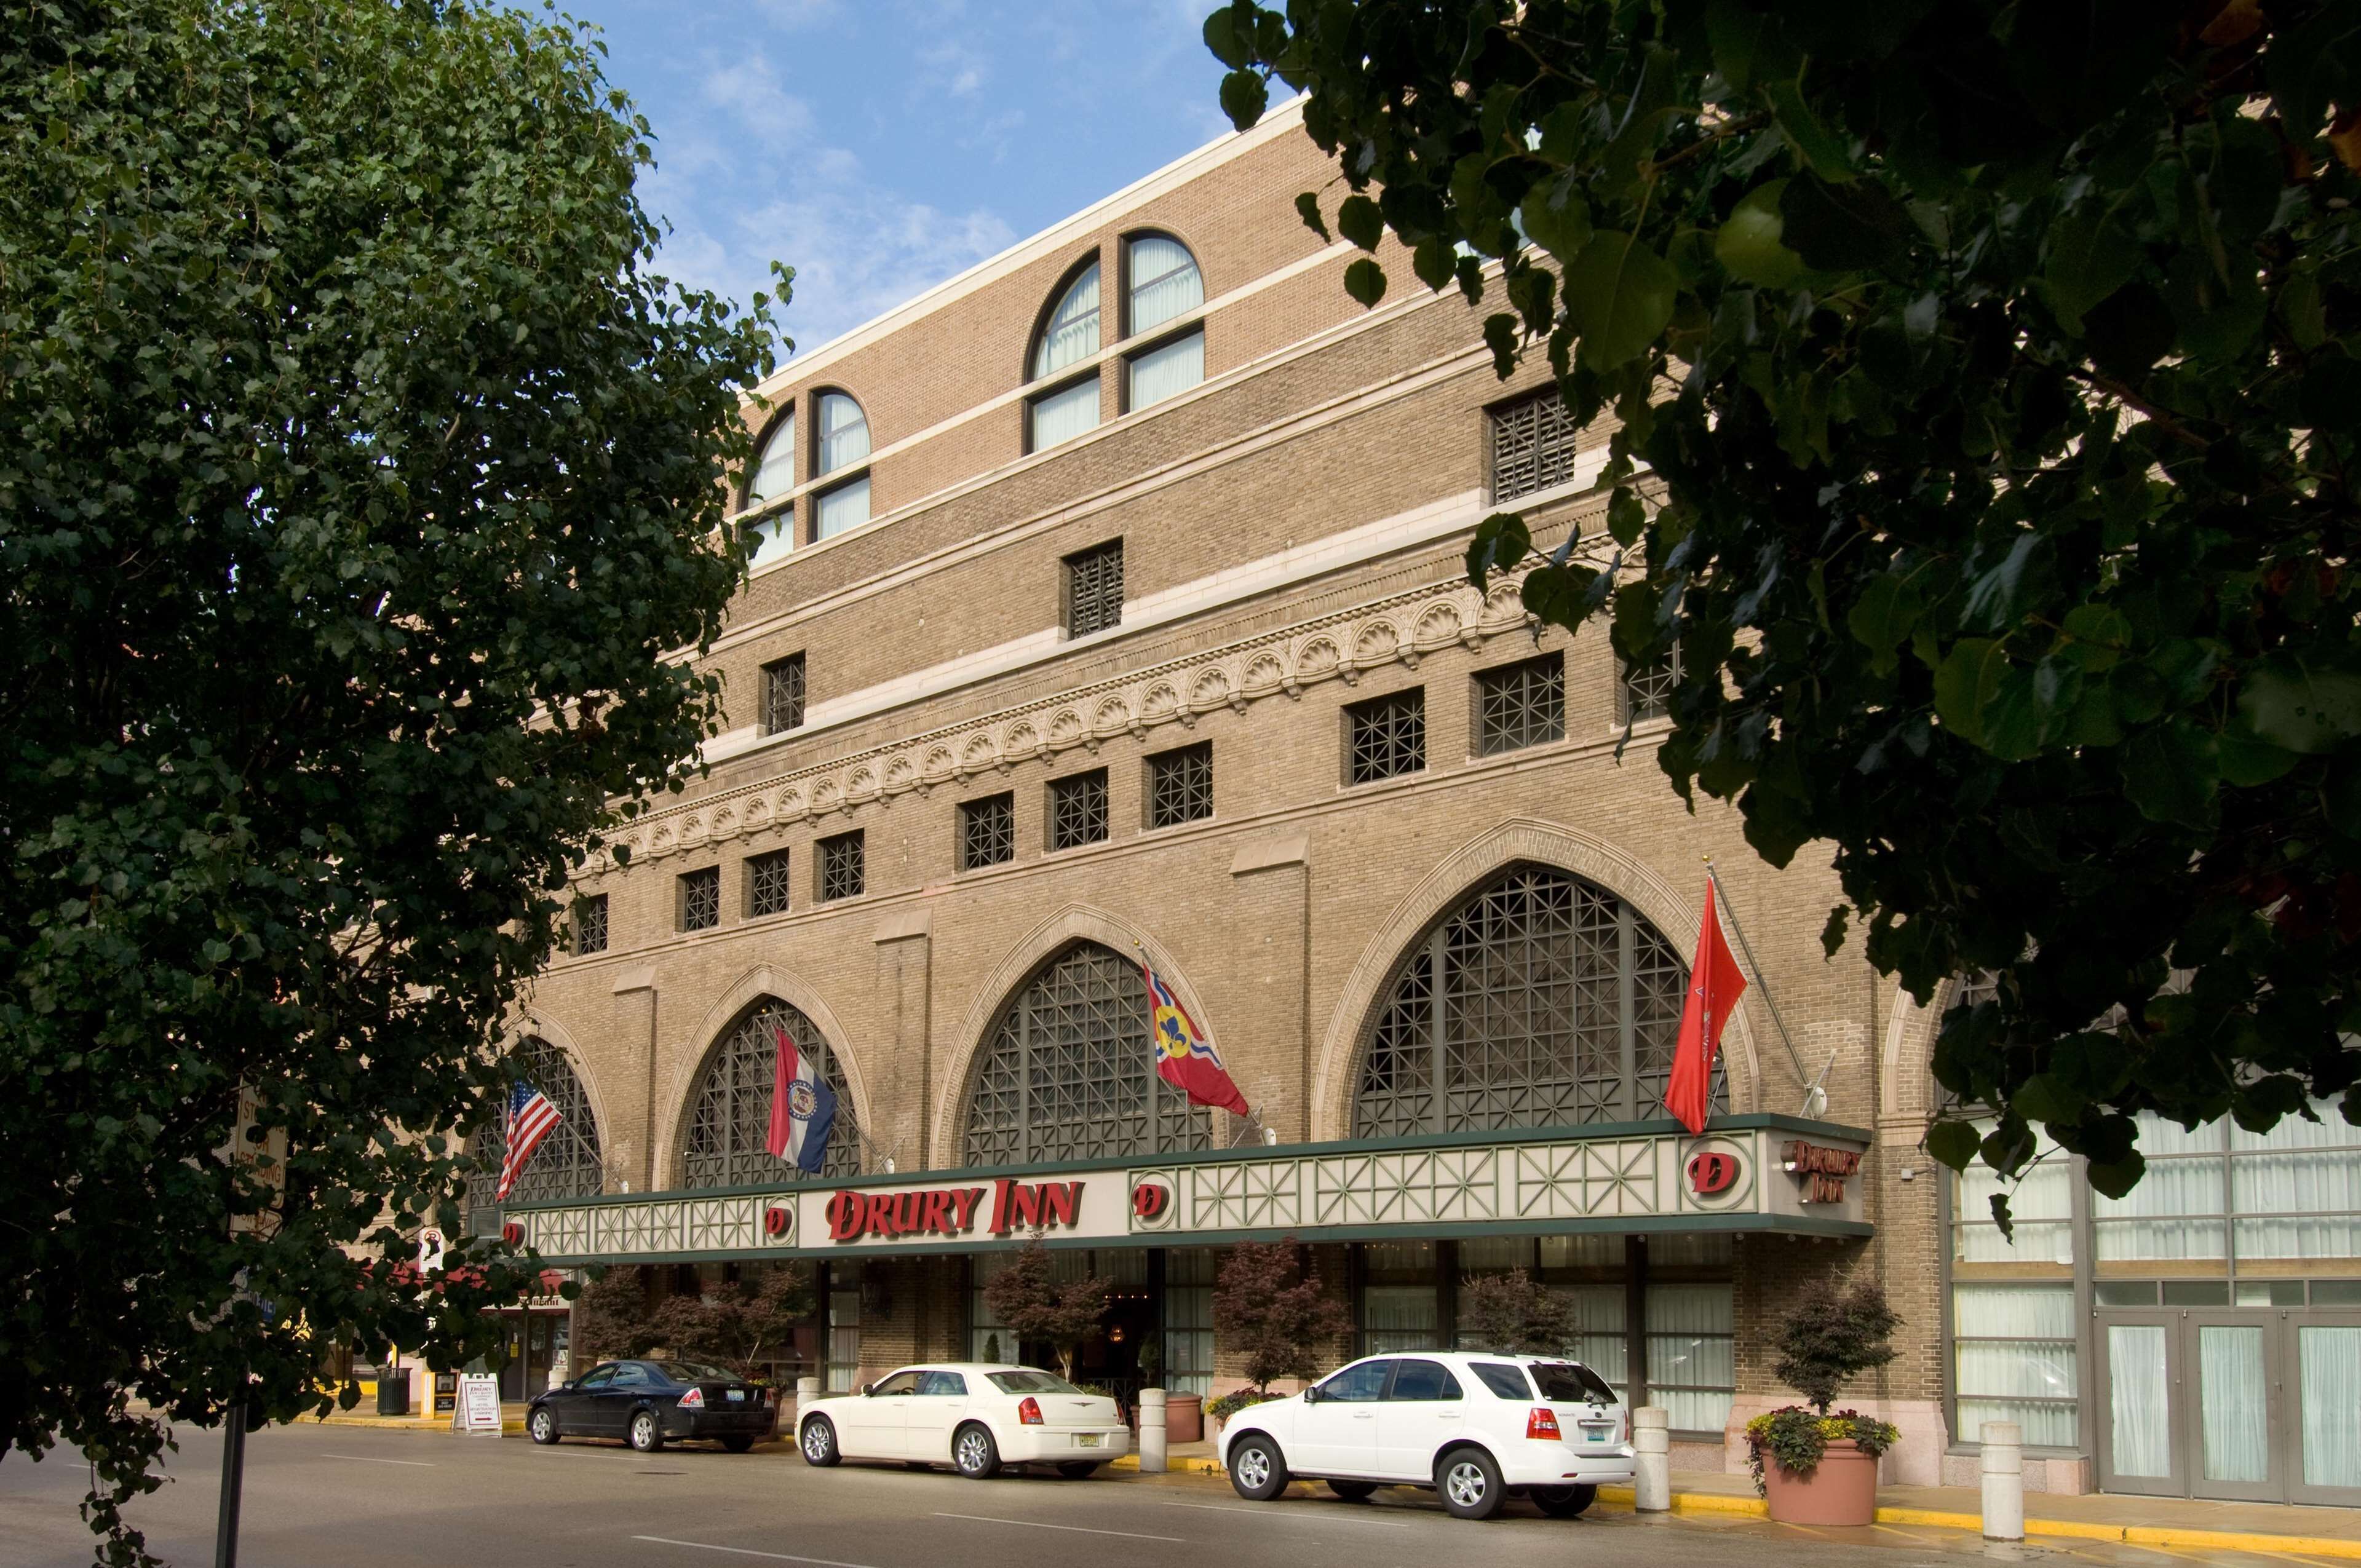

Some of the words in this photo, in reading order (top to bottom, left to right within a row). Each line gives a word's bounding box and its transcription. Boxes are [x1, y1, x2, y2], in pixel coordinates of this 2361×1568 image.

[1780, 1140, 1863, 1177] DRURY
[1807, 1173, 1846, 1203] INN
[825, 1187, 986, 1240] DRURY
[987, 1179, 1085, 1235] INN
